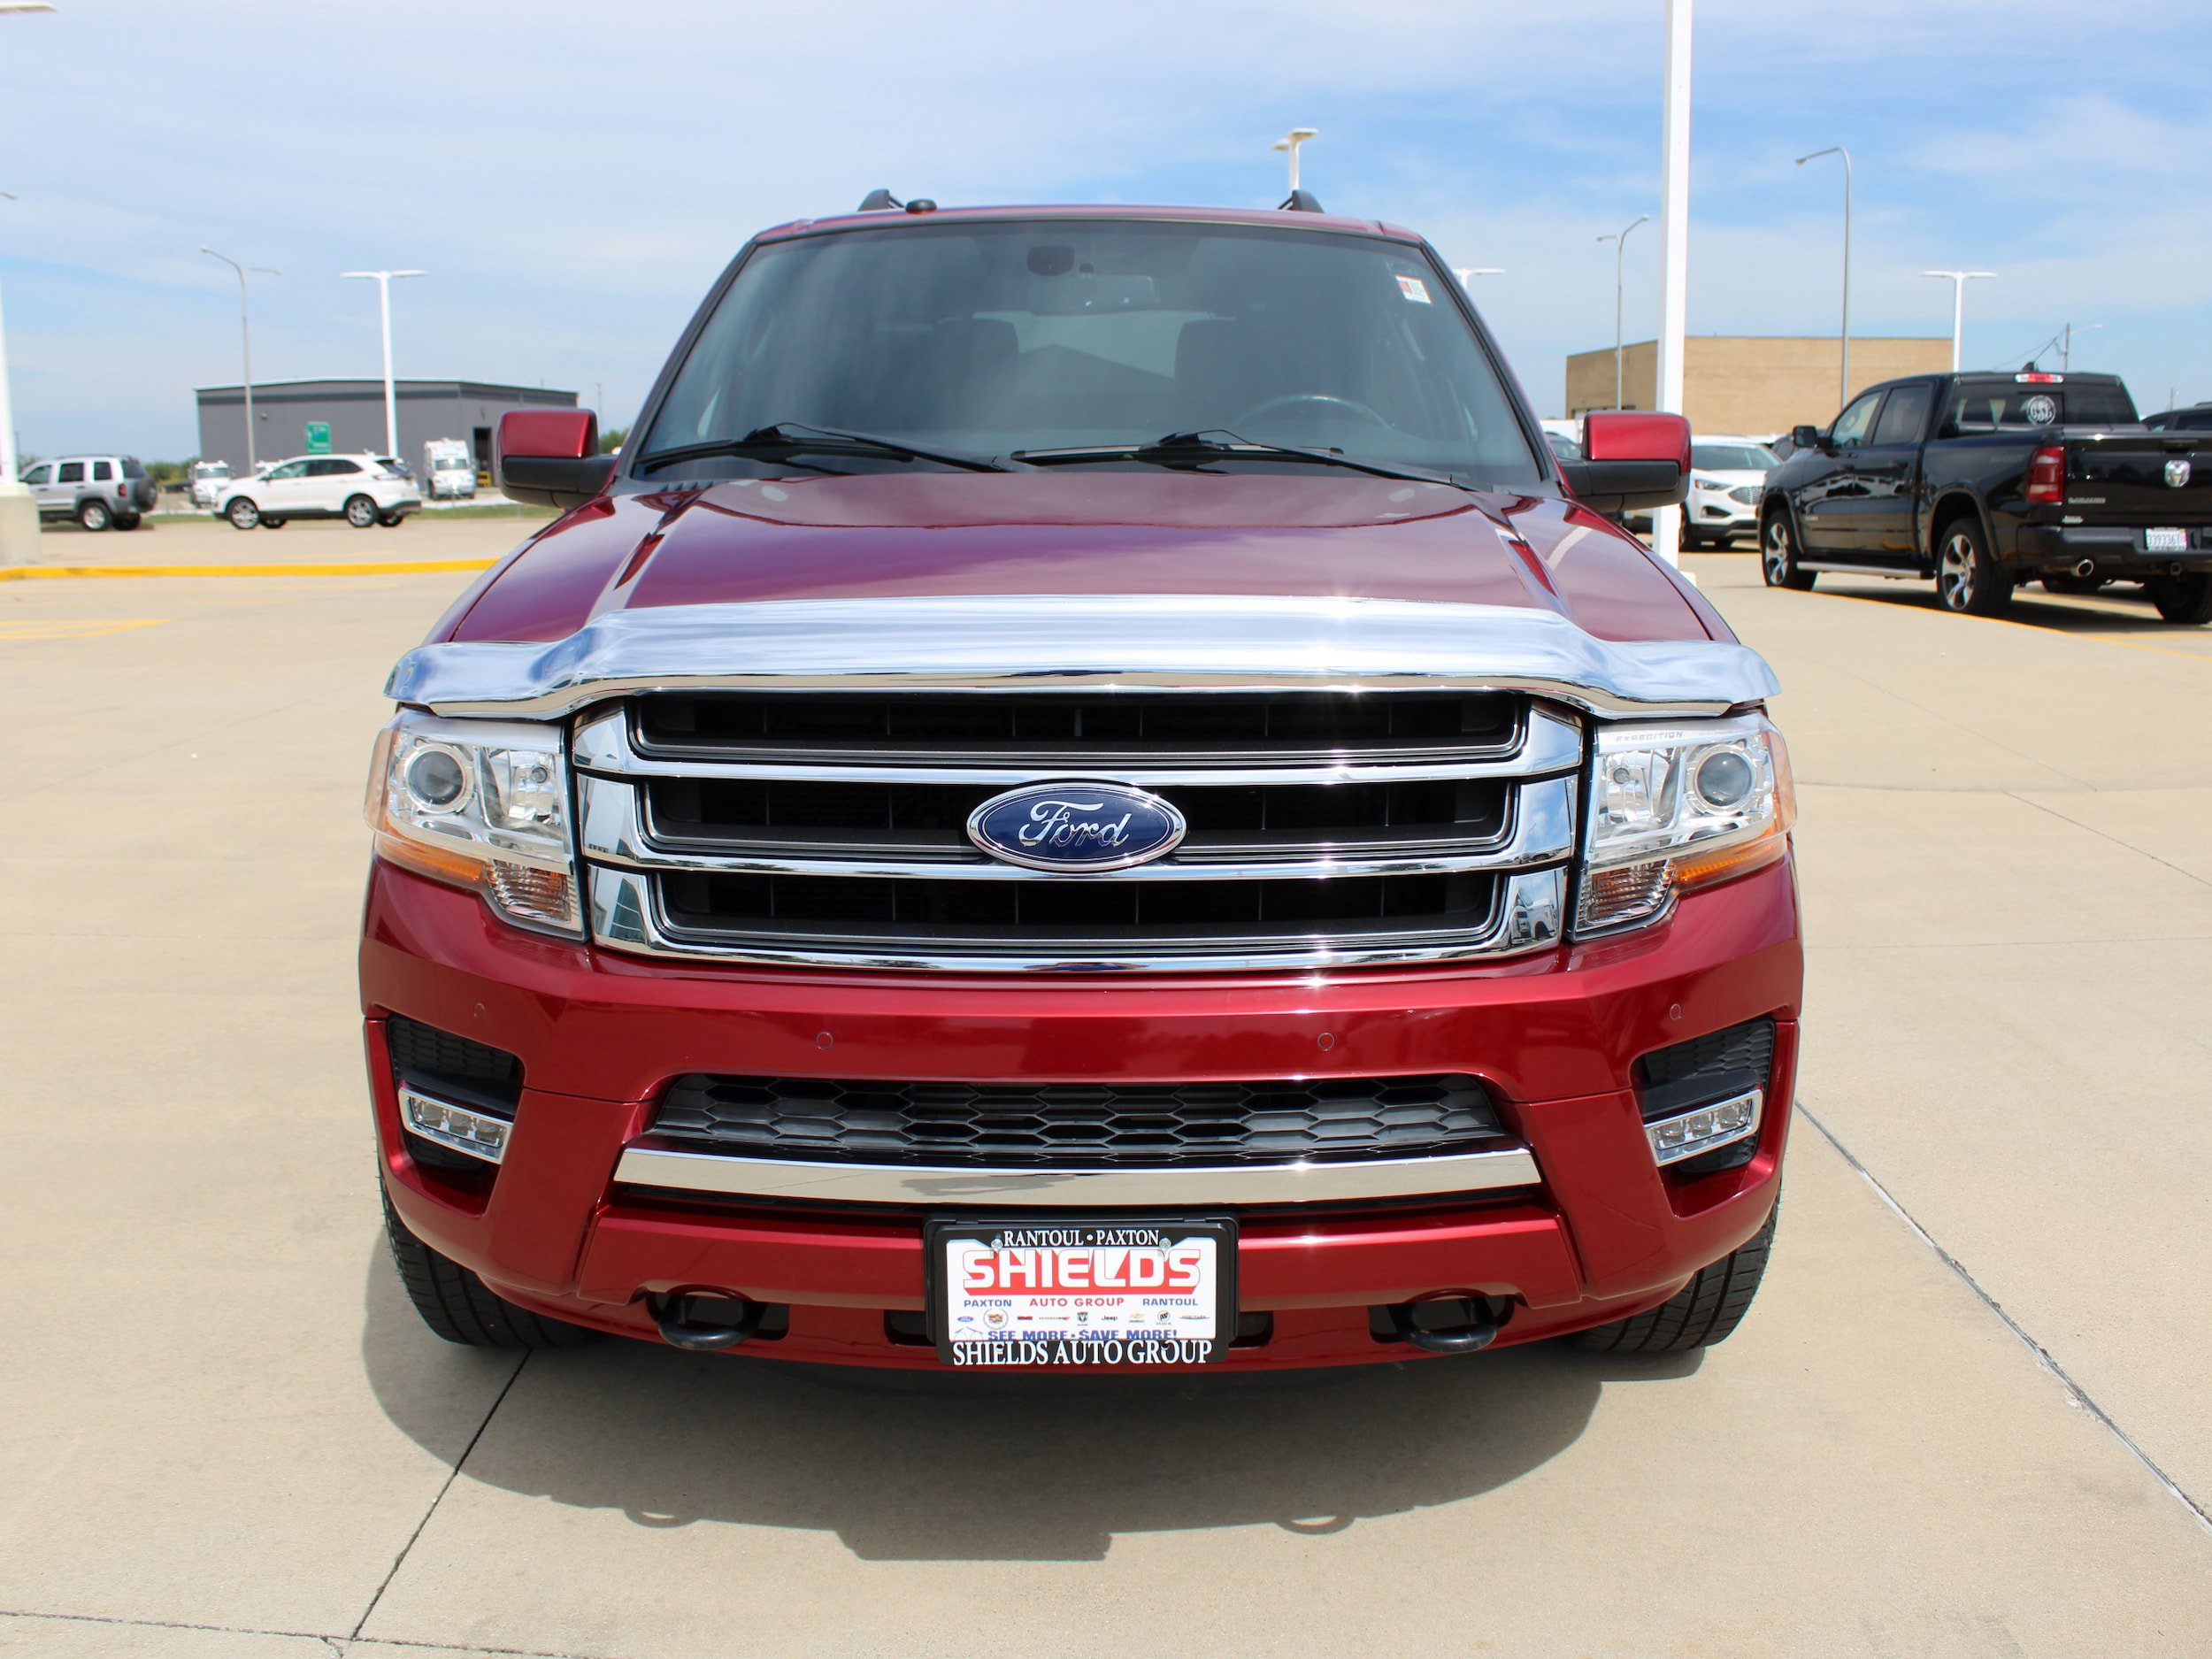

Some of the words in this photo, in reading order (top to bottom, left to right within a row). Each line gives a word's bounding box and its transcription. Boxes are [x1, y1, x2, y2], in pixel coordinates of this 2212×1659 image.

[1616, 731, 1683, 742] EXPEDITION
[1018, 800, 1133, 848] Ford
[1003, 1229, 1084, 1247] RANTOUL
[1096, 1229, 1159, 1247] PAXTON
[963, 1248, 1202, 1294] SHIELDS
[964, 1299, 1012, 1308] PAXTON
[1029, 1297, 1068, 1307] AUTO
[1074, 1297, 1125, 1307] GROUP
[1142, 1297, 1198, 1306] RANTOUL
[953, 1339, 1048, 1365] SHIELDS
[1053, 1340, 1124, 1365] AUTO
[1127, 1338, 1212, 1365] GROUP
